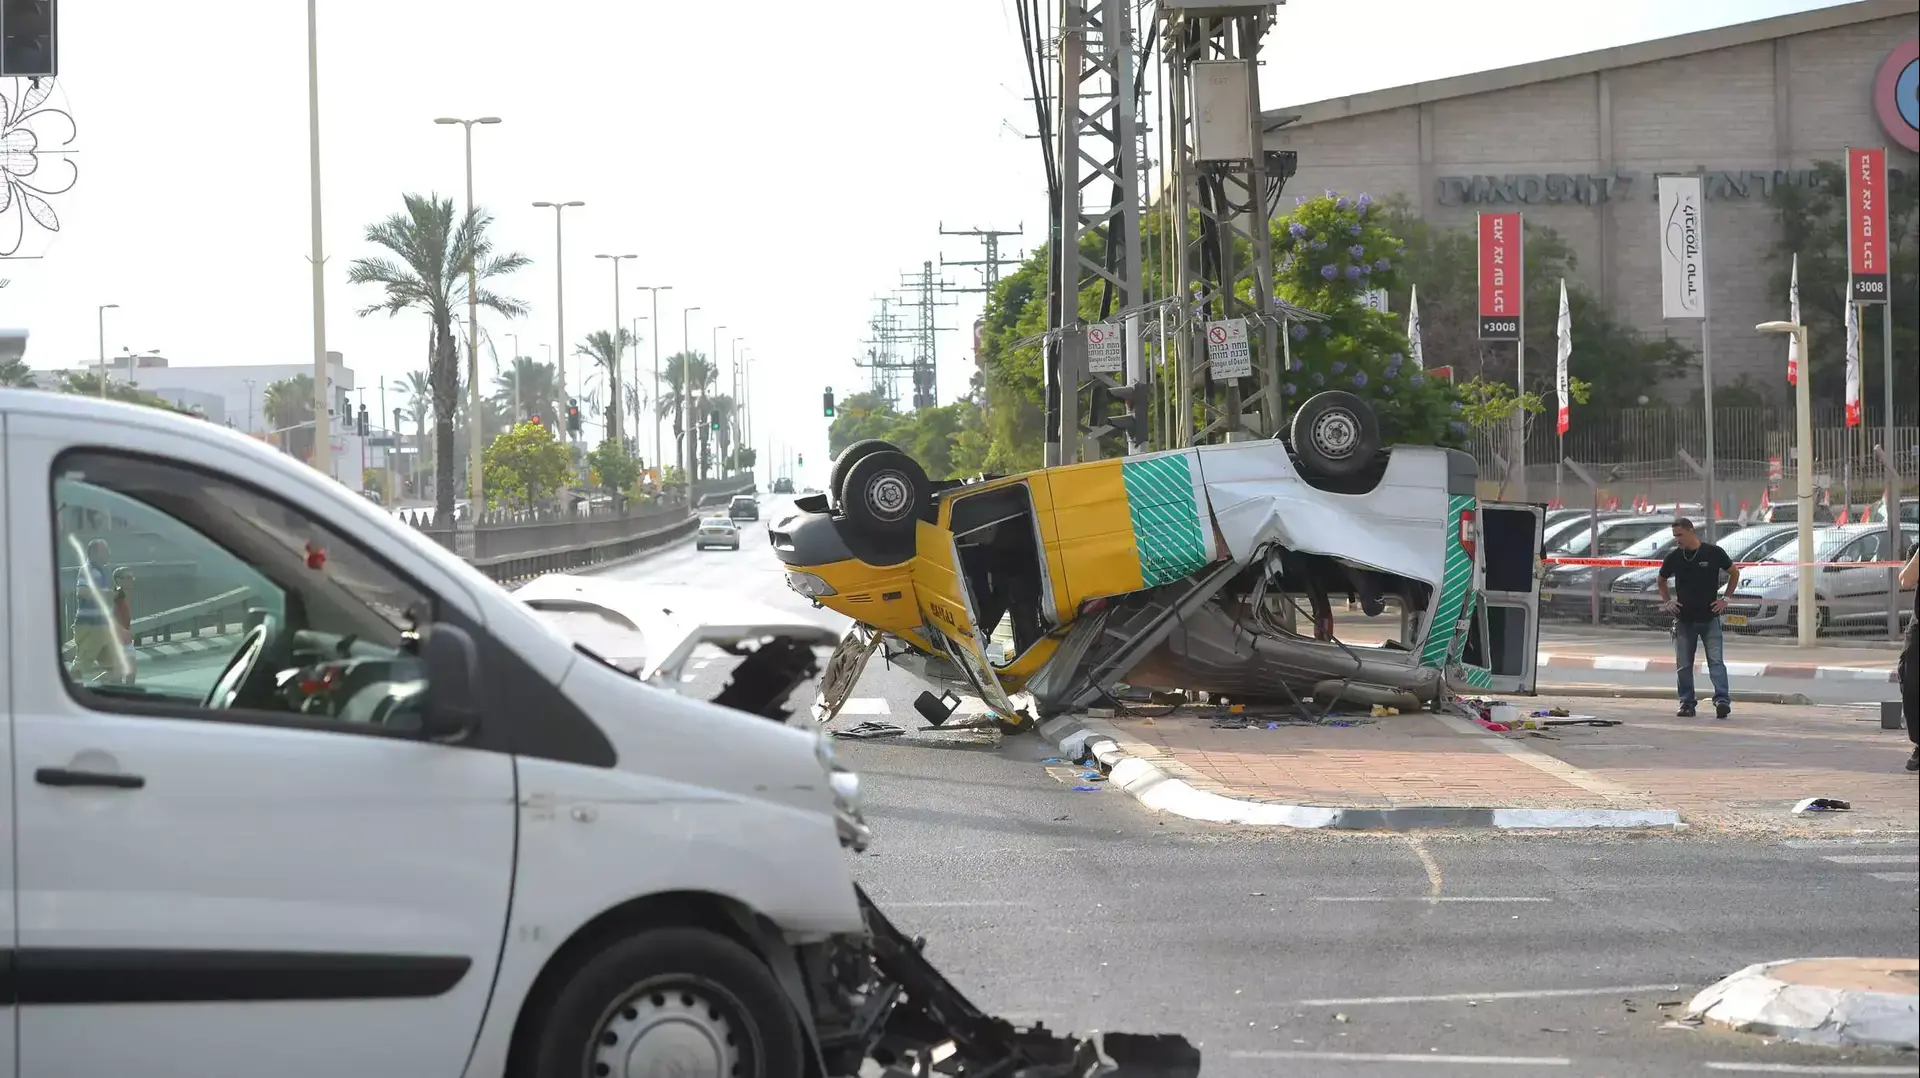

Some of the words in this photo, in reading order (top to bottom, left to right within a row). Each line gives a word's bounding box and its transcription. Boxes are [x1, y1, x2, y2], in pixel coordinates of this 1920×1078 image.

[1862, 154, 1872, 185] בוא,
[1862, 189, 1872, 210] צא
[1494, 217, 1504, 243] בוא,
[1683, 205, 1698, 259] לובינסקי
[1863, 215, 1872, 237] עם
[1494, 246, 1504, 264] צא
[1863, 242, 1873, 269] רכב
[1494, 268, 1504, 286] עם
[1687, 263, 1697, 296] טרייד
[1494, 290, 1504, 313] רכב
[1230, 349, 1248, 358] סכנת
[1231, 341, 1247, 350] מתח
